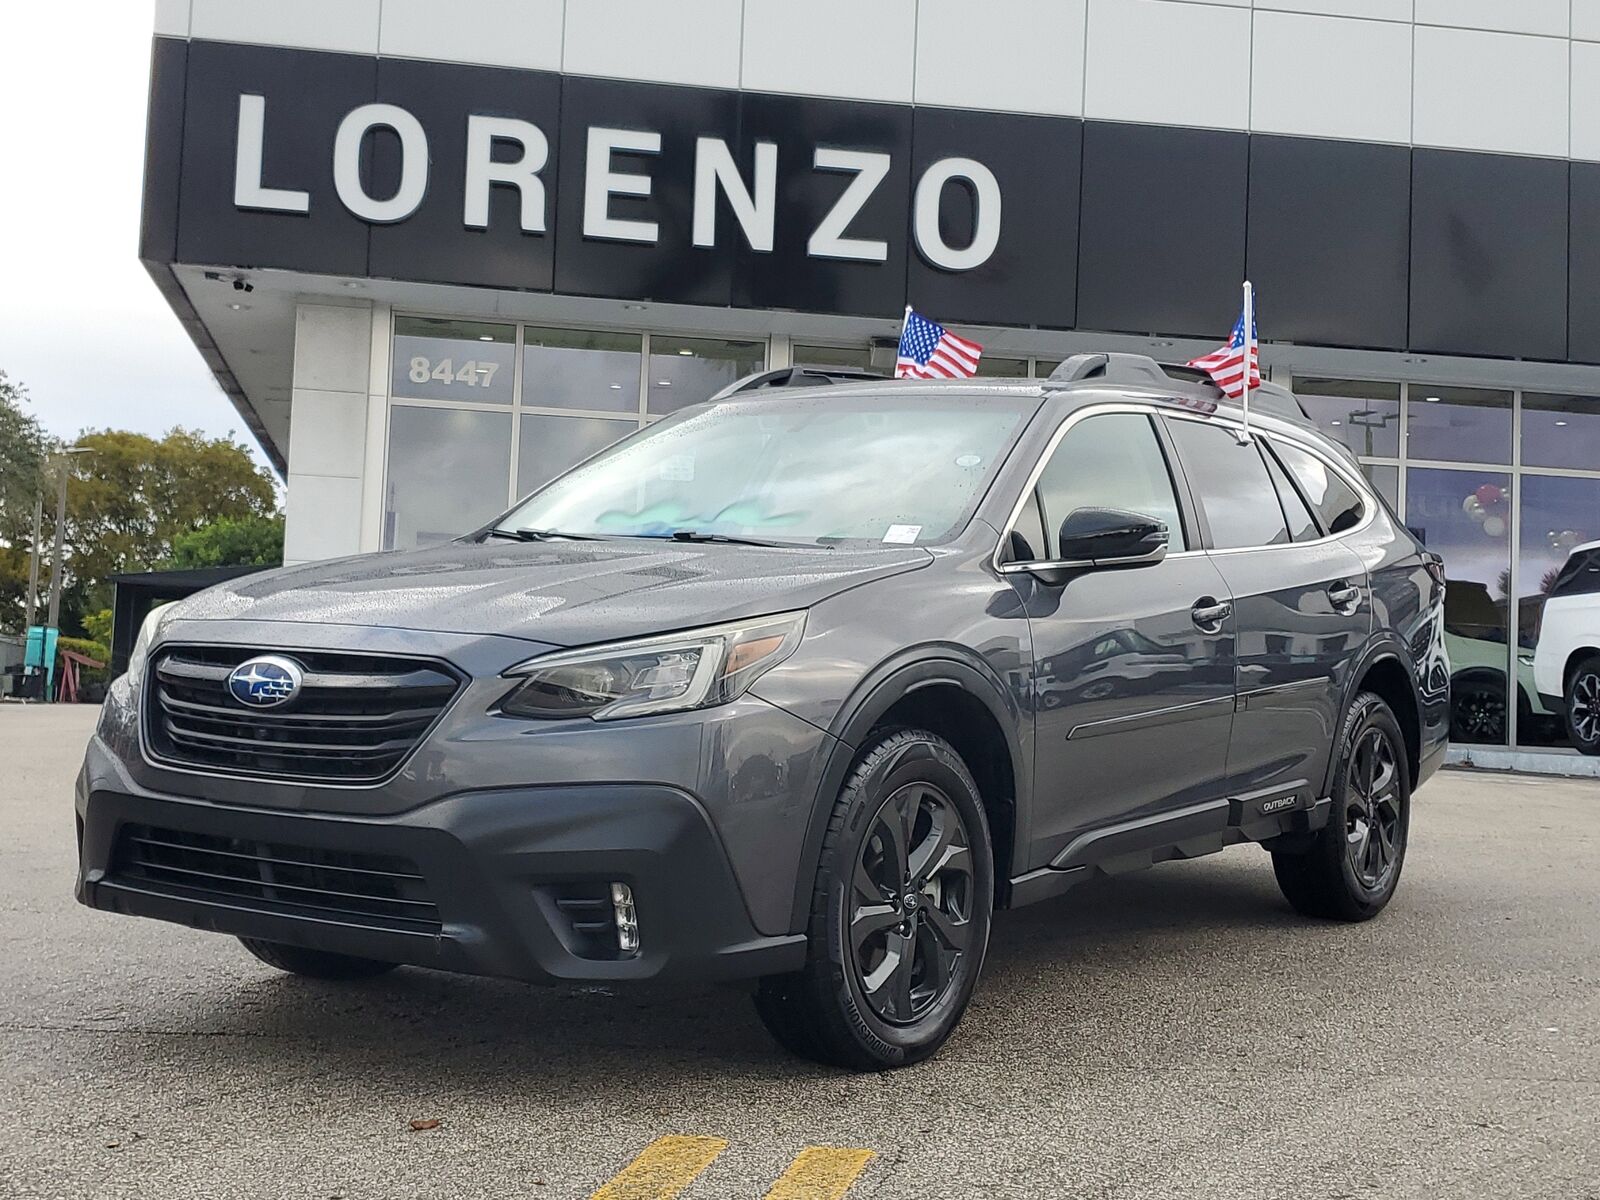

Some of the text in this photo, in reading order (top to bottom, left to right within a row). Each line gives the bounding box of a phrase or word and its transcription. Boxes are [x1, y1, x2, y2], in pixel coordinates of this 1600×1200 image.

[233, 94, 1001, 271] LORENZO
[408, 356, 500, 388] 8447
[1263, 796, 1296, 811] OUTBACK
[845, 997, 897, 1058] BRIDGESTONE
